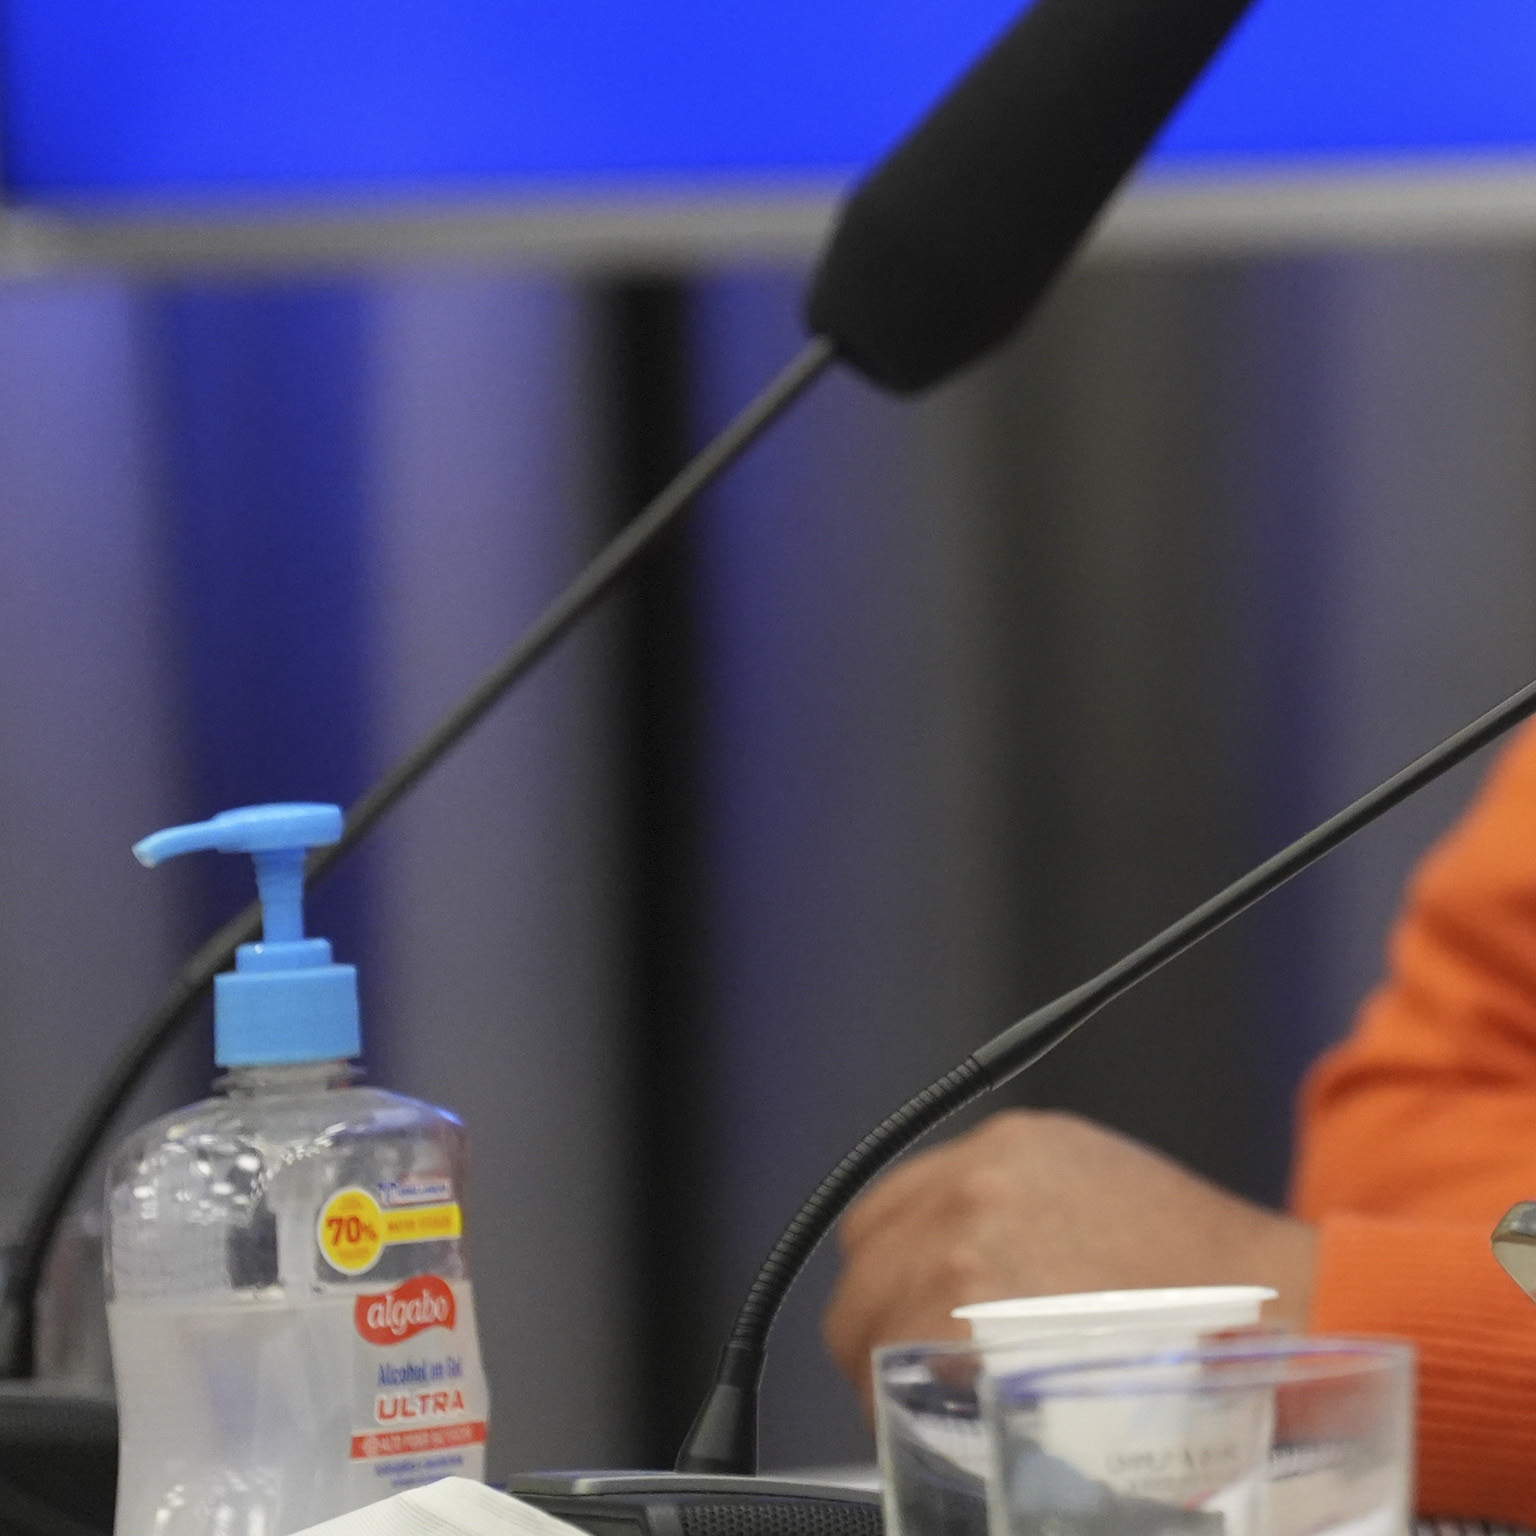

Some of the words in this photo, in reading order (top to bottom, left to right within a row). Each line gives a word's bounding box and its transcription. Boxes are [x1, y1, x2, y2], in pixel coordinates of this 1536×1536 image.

[326, 1215, 379, 1247] 70%
[366, 1287, 450, 1336] algabo
[377, 1389, 466, 1421] ULTRA
